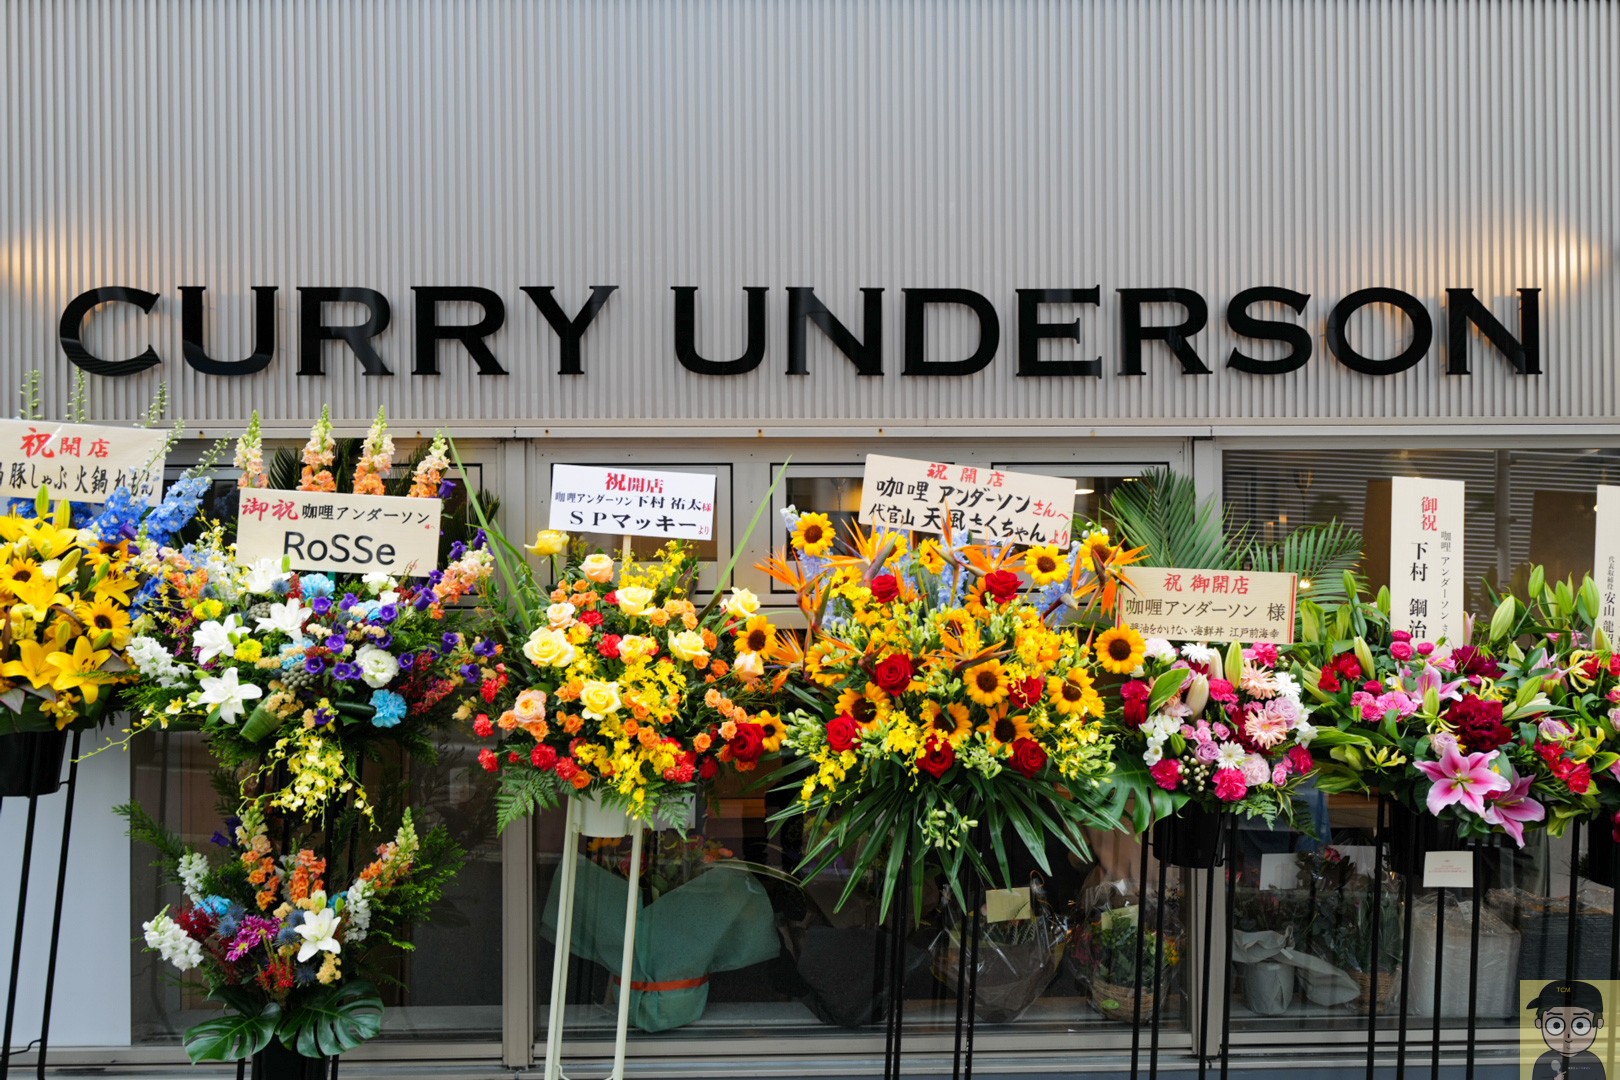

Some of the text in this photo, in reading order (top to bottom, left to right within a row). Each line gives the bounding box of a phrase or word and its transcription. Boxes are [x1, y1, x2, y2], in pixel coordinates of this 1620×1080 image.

[59, 284, 1544, 378] CURRY UNDERSON
[20, 427, 111, 459] 祝開店
[605, 472, 664, 494] 祝開店
[241, 497, 299, 522] 御祝
[1421, 496, 1438, 532] 御祝
[283, 531, 396, 566] RoSSe
